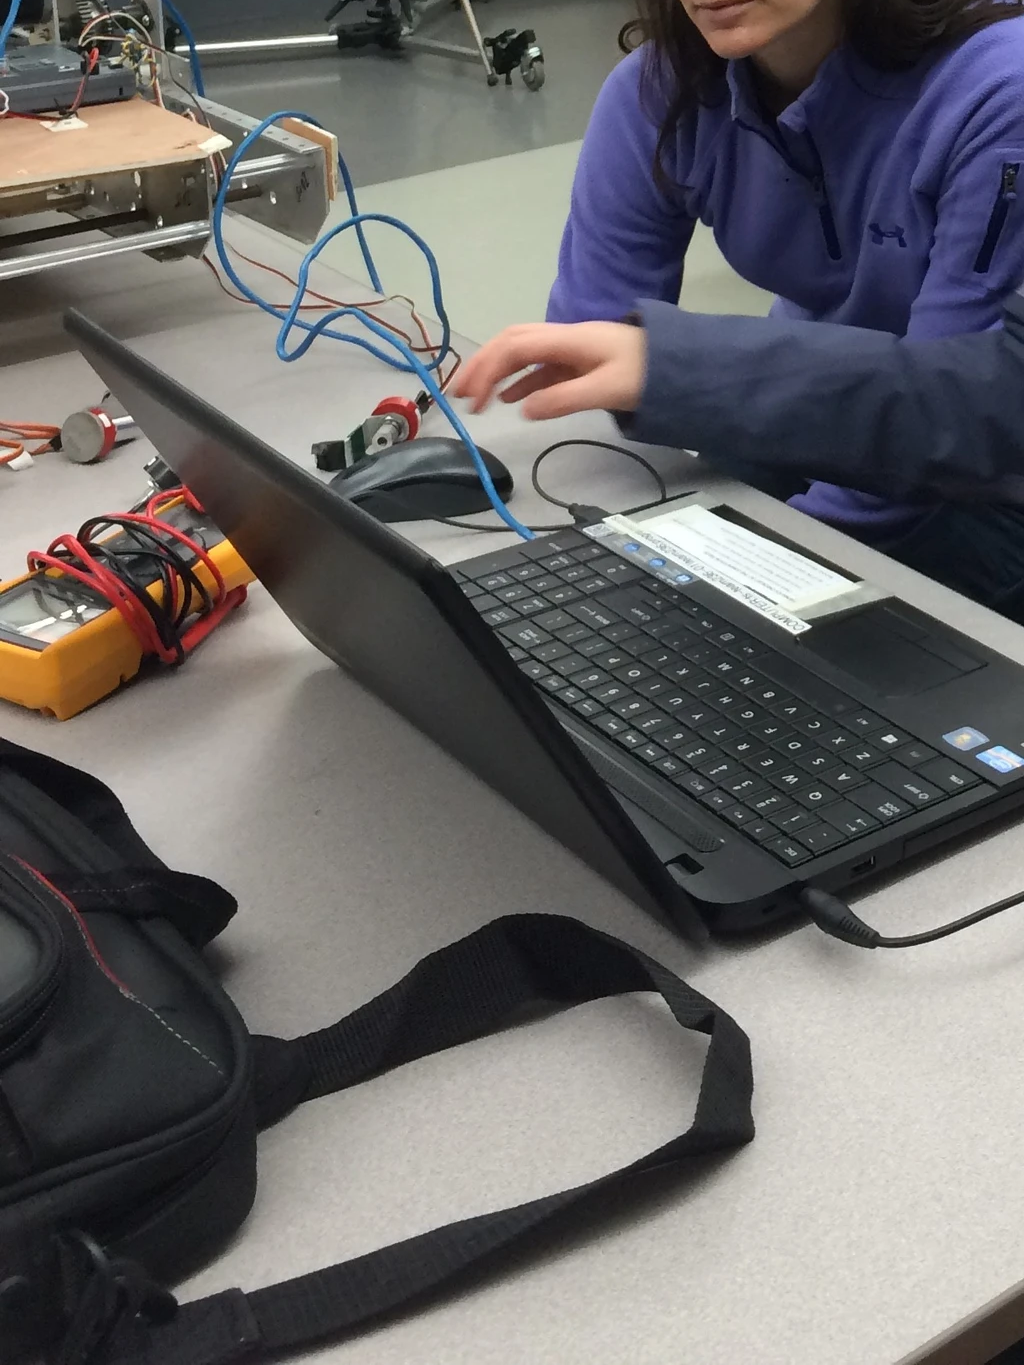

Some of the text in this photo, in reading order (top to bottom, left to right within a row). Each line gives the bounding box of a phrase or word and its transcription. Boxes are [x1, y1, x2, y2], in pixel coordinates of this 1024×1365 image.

[750, 597, 805, 631] COMPUTER
[718, 663, 732, 671] M
[740, 677, 754, 685] N
[719, 696, 732, 704] H
[856, 752, 870, 760] Z
[782, 775, 798, 784] W
[809, 792, 822, 800] Q
